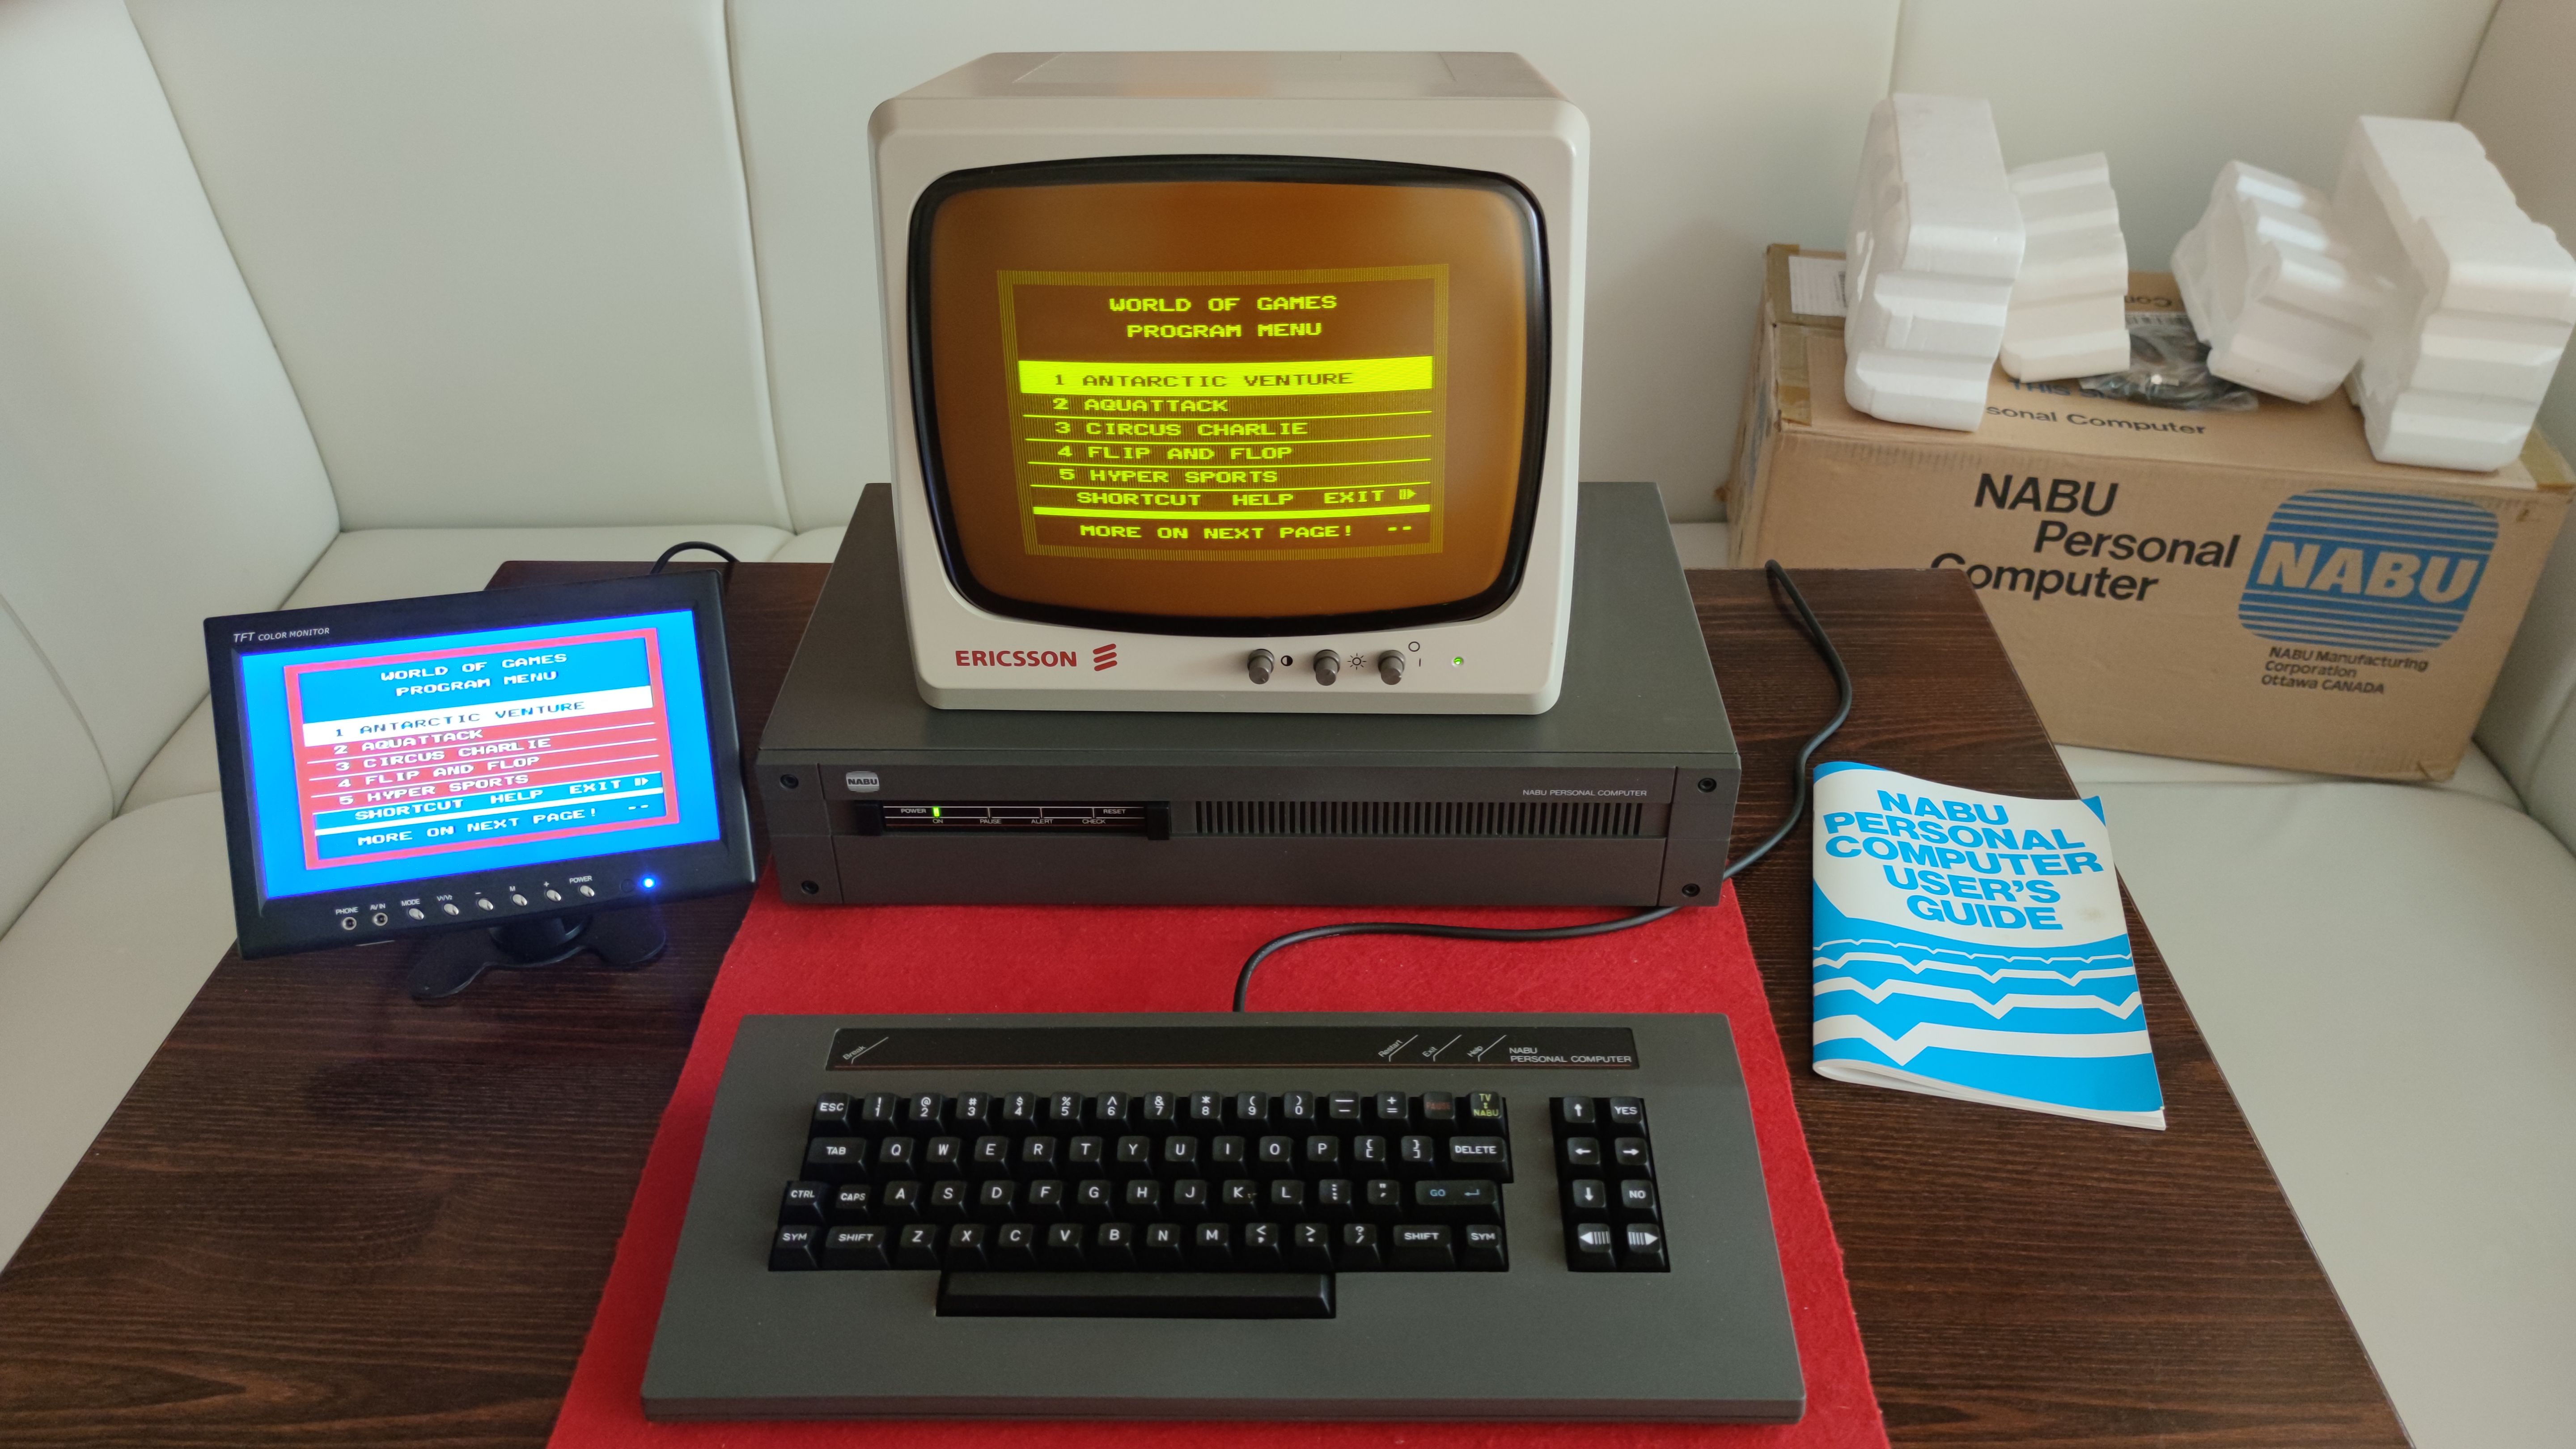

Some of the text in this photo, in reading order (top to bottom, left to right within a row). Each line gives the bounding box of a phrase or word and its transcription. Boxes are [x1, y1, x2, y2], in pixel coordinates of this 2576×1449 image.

[1110, 295, 1337, 312] WORLD OF GAMES
[1127, 322, 1322, 338] PROGRAM MENU
[1055, 373, 1353, 387] 1 ANTARCTIC VENTURE
[1053, 398, 1228, 412] 2 AQUATTACK
[1986, 406, 2206, 434] sonal Computer
[1055, 422, 1308, 436] 3 CIRCUS CHARLIE
[1057, 445, 1292, 460] 4 FLIP AND FLOP
[1059, 469, 1277, 483] 5 HYPER SPORTS
[1076, 490, 1385, 506] SHORTCUT HELP EXIT
[1974, 473, 2119, 517] NABU
[1080, 525, 1352, 540] MORE ON NEXT PAGE!
[2034, 520, 2241, 568] Personal
[2256, 540, 2481, 603] NABU
[233, 627, 330, 643] TFT COLOR MONITOR
[955, 650, 1077, 667] ERICSSON
[2269, 647, 2428, 672] NABU Manufacturing
[381, 653, 567, 681] WORLD OF GAMES
[2265, 660, 2357, 679] Corporation
[395, 671, 559, 697] PROGRAM MENU
[2262, 674, 2385, 694] Ottawa CANADA
[336, 702, 585, 737] 1 ANTARCTIC VENTURE
[334, 729, 483, 755] 2 AQUATTACK
[335, 738, 551, 771] 3 CIRCUS CHARLIE
[338, 757, 540, 788] 4 FLIP AND FLOP
[339, 775, 529, 805] 5 HYPER SPORTS
[355, 780, 621, 820] SHORTCUT HELP EXIT
[1877, 790, 2008, 825] NABU
[358, 808, 596, 846] MORE ON NEXT PAGE!
[1823, 812, 2085, 850] PERSONAL
[1825, 835, 2104, 876] COMPUTER
[401, 898, 420, 907] MODE
[335, 907, 358, 915] PHONE
[1907, 895, 2063, 930] GUIDE
[843, 1046, 866, 1060] Break
[1378, 1039, 1402, 1058] Restart
[1422, 1046, 1437, 1058] Exit
[1467, 1045, 1483, 1057] Help
[1479, 1093, 1491, 1102] TV
[819, 1102, 843, 1112] ESC
[875, 1105, 881, 1117] 1
[920, 1105, 929, 1117] 2
[967, 1106, 976, 1116] 3
[1014, 1105, 1022, 1116] 4
[1061, 1106, 1069, 1116] 5
[1107, 1106, 1115, 1116] 6
[1155, 1106, 1163, 1115] 7
[1201, 1106, 1210, 1116] 8
[1248, 1106, 1256, 1116] 9
[1295, 1105, 1303, 1115] 0
[1614, 1106, 1637, 1115] YES
[826, 1146, 846, 1155] TAB
[891, 1144, 902, 1156] Q
[938, 1144, 949, 1156] W
[985, 1143, 996, 1156] E
[1033, 1143, 1043, 1155] R
[1080, 1143, 1091, 1155] T
[1128, 1143, 1138, 1155] Y
[1175, 1143, 1186, 1156] U
[1225, 1143, 1230, 1155] I
[1269, 1143, 1280, 1155] O
[1318, 1143, 1327, 1154] P
[1454, 1145, 1496, 1154] DELETE
[790, 1190, 814, 1198] CTRL
[840, 1192, 865, 1201] CAPS
[895, 1187, 905, 1199] A
[943, 1187, 953, 1199] S
[991, 1186, 1003, 1199] D
[1040, 1186, 1051, 1198] F
[1089, 1186, 1099, 1198] G
[1136, 1186, 1148, 1198] H
[1185, 1186, 1195, 1198] J
[1233, 1186, 1243, 1198] K
[1281, 1186, 1291, 1198] L
[1429, 1188, 1446, 1197] GO
[1629, 1190, 1645, 1199] NO
[782, 1233, 807, 1241] SYM
[838, 1233, 873, 1242] SHIFT
[912, 1230, 924, 1242] Z
[962, 1230, 972, 1241] X
[1010, 1229, 1021, 1241] C
[1060, 1229, 1071, 1241] V
[1109, 1229, 1120, 1241] B
[1158, 1230, 1168, 1241] N
[1206, 1229, 1218, 1240] M
[1404, 1232, 1439, 1240] SHIFT
[1470, 1232, 1495, 1241] SYM
